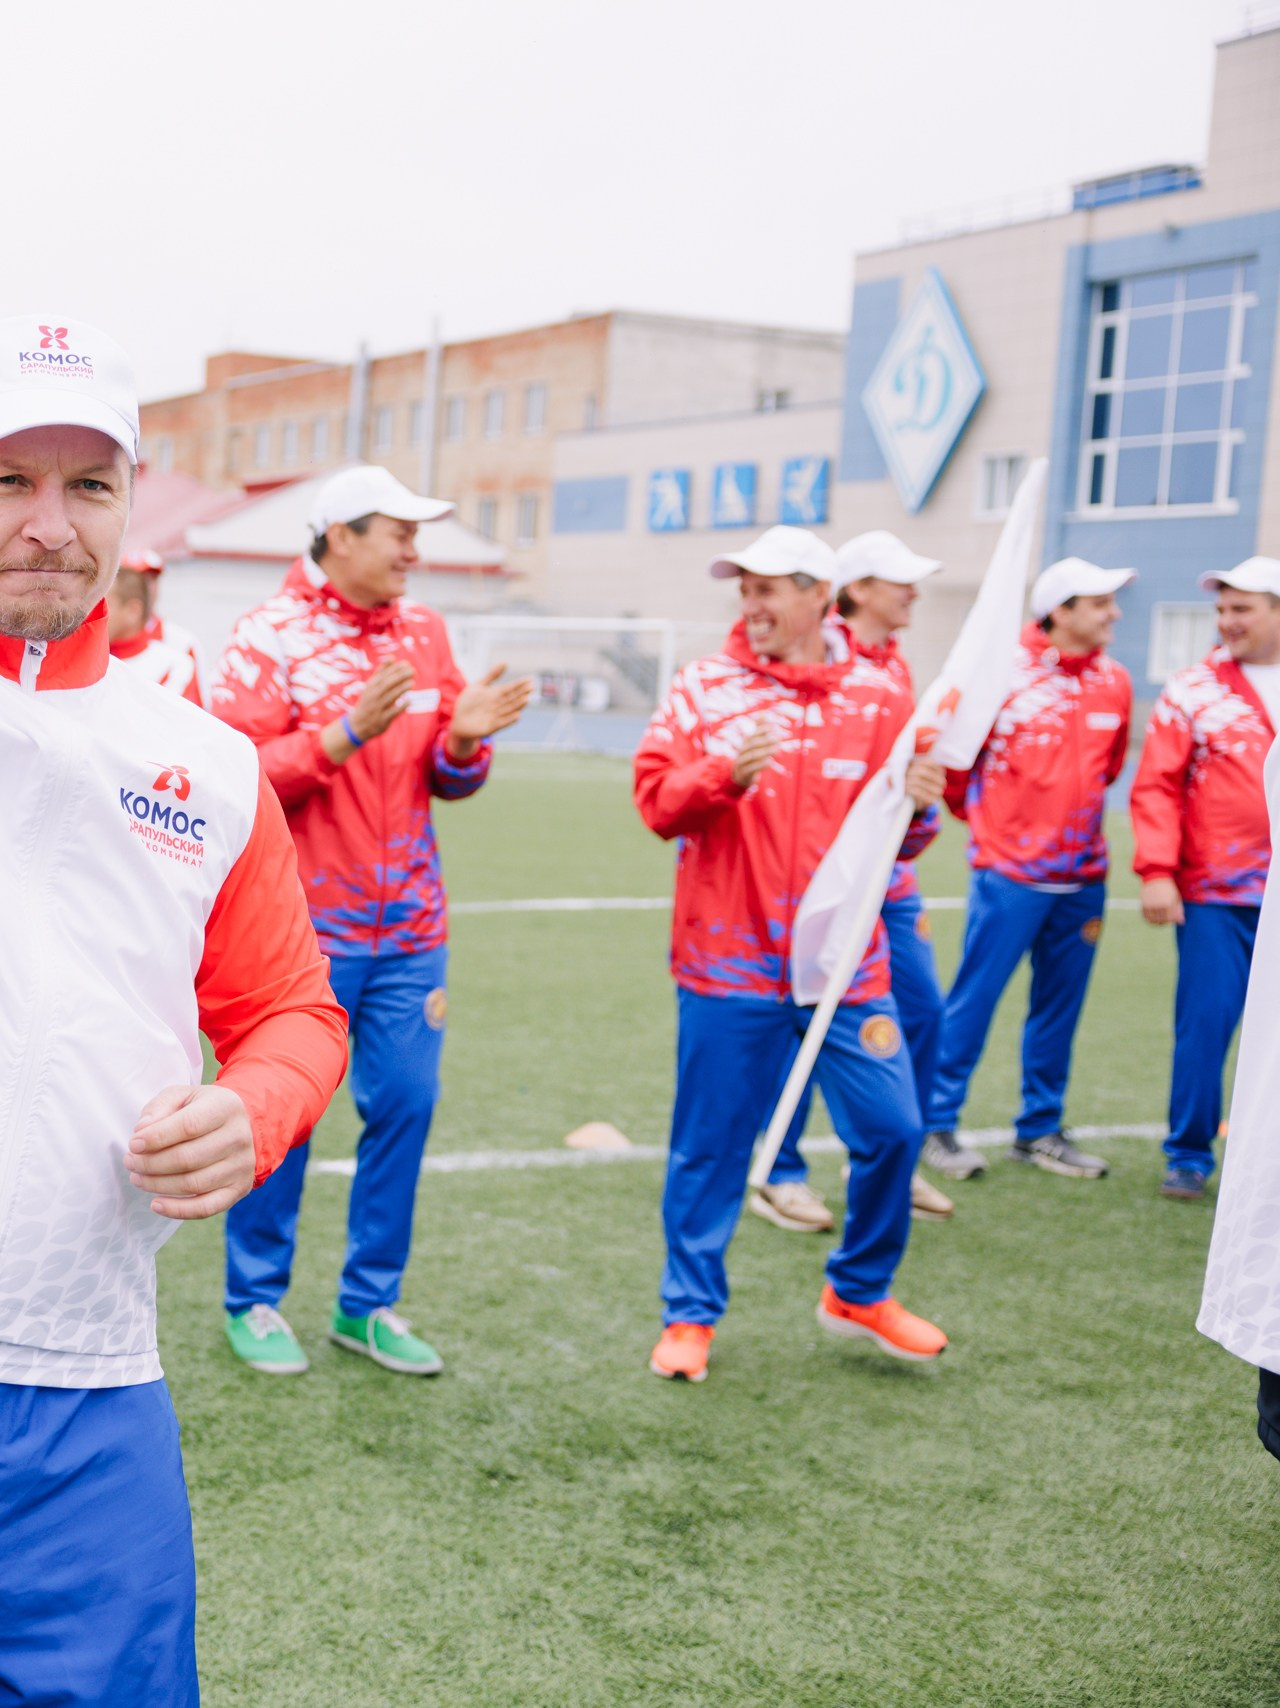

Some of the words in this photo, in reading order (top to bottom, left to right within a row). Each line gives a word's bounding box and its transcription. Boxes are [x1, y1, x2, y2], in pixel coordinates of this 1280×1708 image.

[19, 352, 93, 367] КОМОС
[20, 362, 95, 375] САРАПУЛЬСКИЙ
[120, 787, 206, 841] КОМОС
[145, 841, 203, 868] КОМБИНАТ
